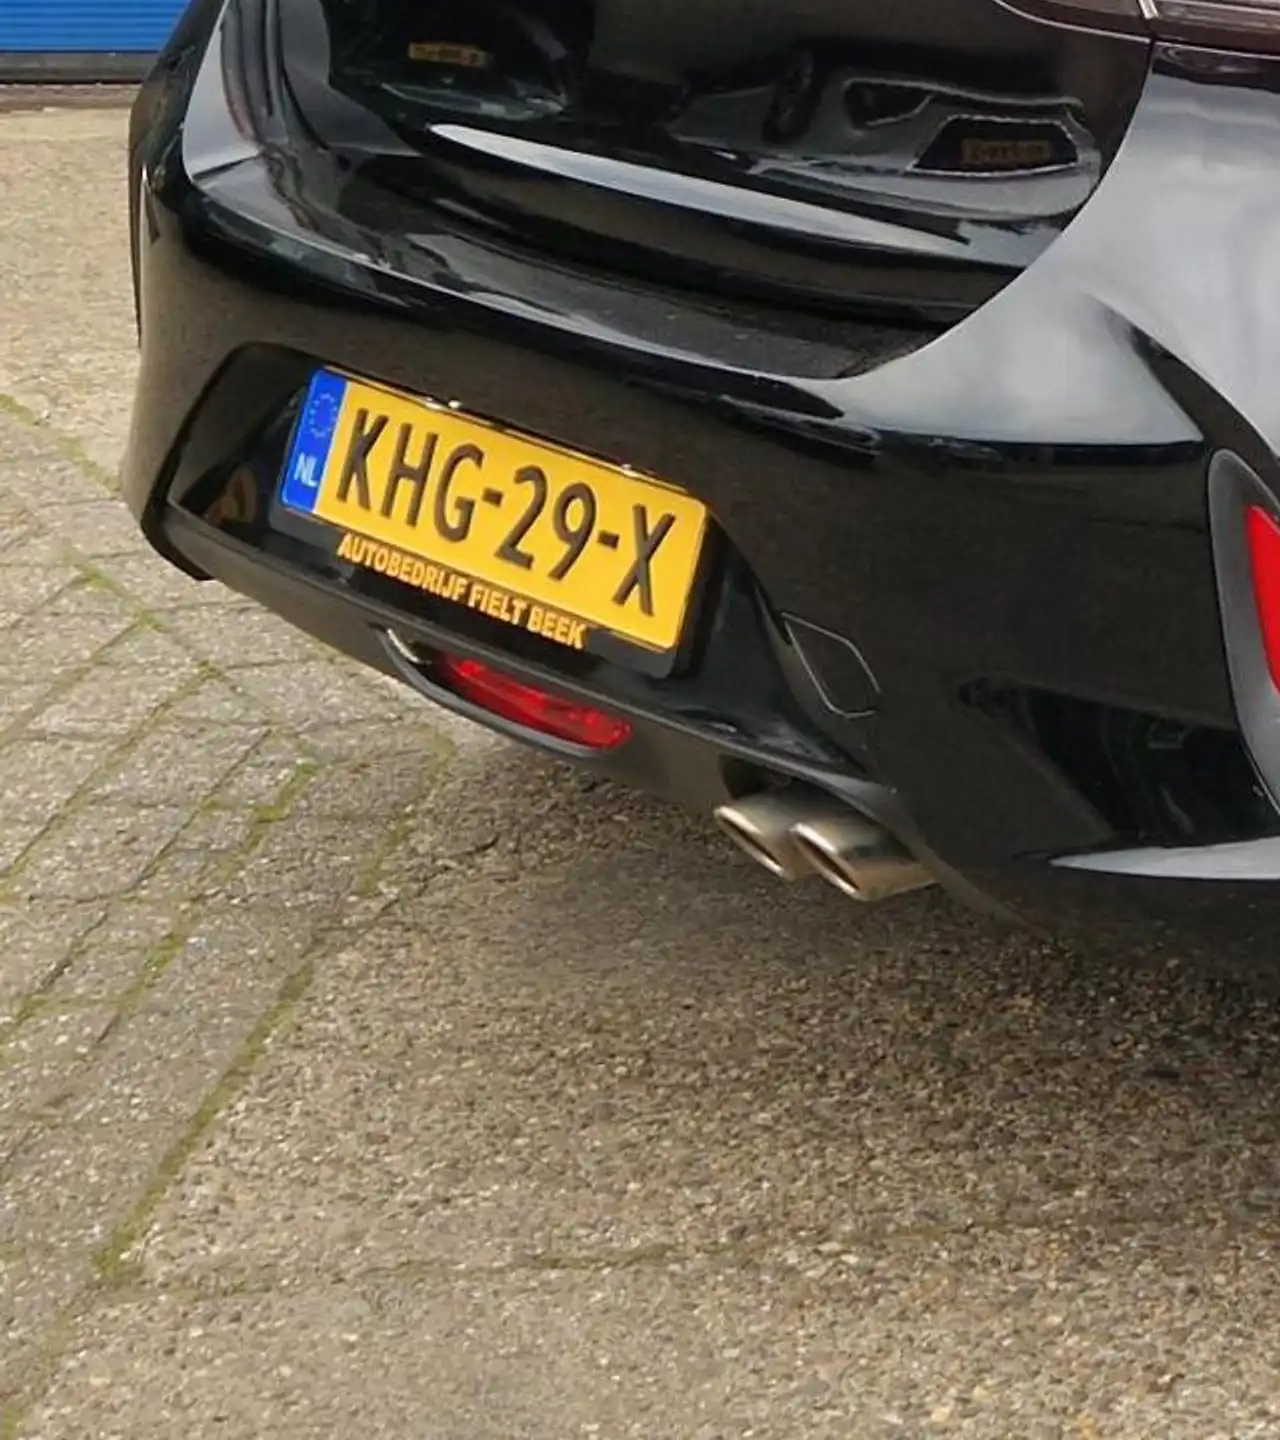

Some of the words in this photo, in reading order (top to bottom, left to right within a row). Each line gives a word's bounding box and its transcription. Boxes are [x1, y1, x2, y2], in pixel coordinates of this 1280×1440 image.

[295, 452, 319, 488] NL
[336, 408, 676, 617] KHG-29-X
[337, 533, 468, 602] AUTOBEDRIJF
[467, 583, 528, 626] FIELT
[527, 607, 588, 650] BEEK
